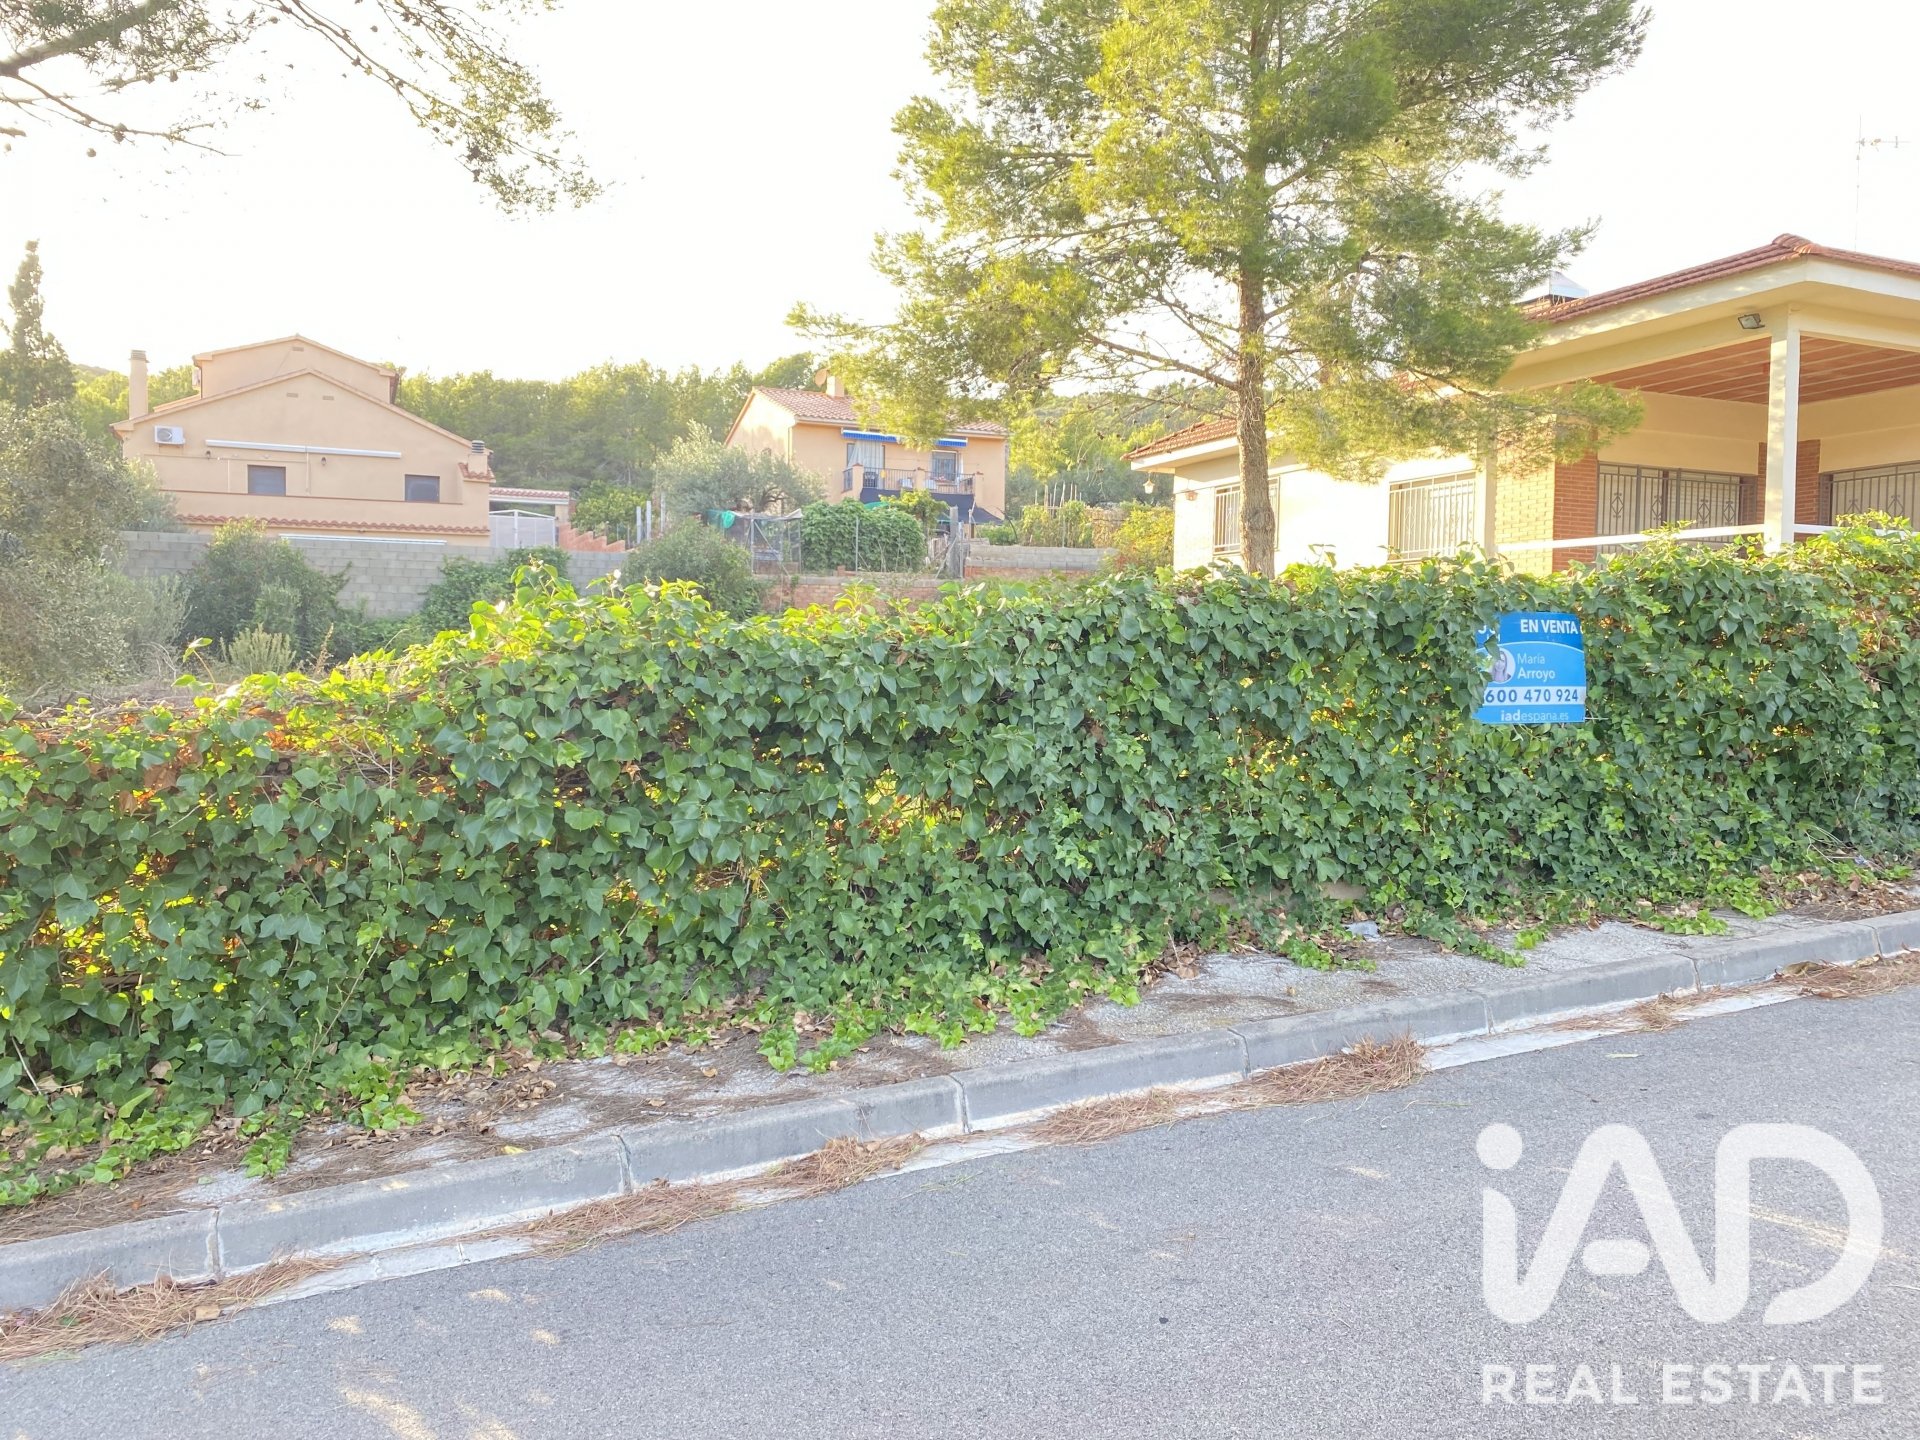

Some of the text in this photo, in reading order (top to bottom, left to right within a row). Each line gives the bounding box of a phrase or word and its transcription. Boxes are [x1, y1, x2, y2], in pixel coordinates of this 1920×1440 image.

[1520, 619, 1539, 633] EN
[1541, 619, 1578, 634] VENTA
[1517, 667, 1556, 682] Arroyo
[1485, 689, 1579, 703] 600 470 924
